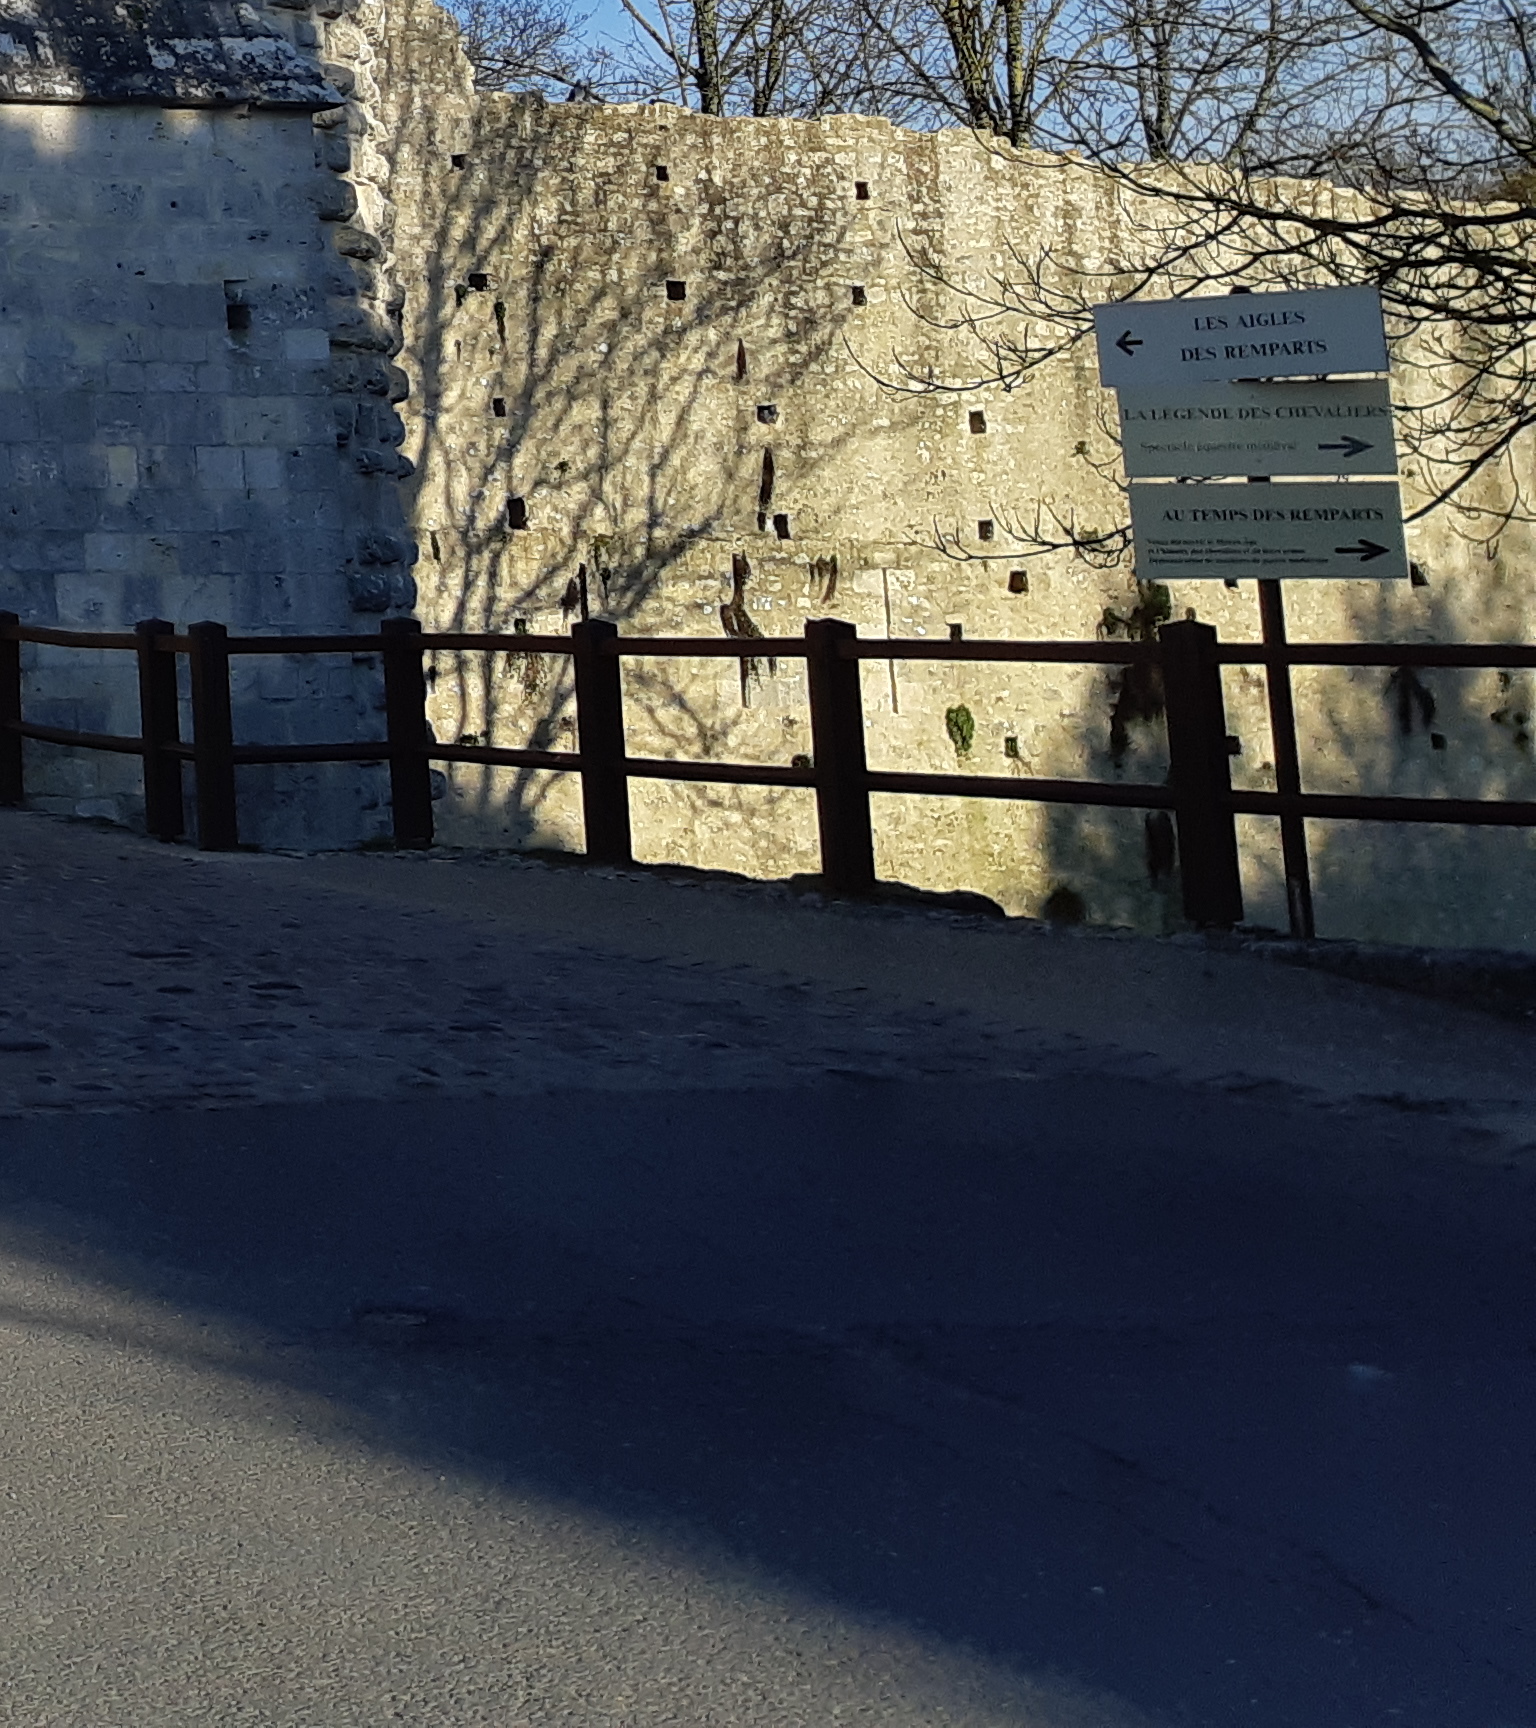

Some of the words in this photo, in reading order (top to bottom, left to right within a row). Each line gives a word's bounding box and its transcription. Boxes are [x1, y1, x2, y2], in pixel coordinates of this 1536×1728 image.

[1193, 315, 1228, 332] LES
[1236, 311, 1306, 329] AIGLES
[1180, 346, 1217, 362] DES
[1224, 339, 1328, 360] REMPARTS
[1124, 408, 1147, 422] LA
[1237, 406, 1271, 420] DES
[1275, 405, 1388, 419] CHEVALIERS
[1162, 509, 1185, 522] AU
[1190, 509, 1249, 522] TEMPS
[1252, 509, 1285, 522] DES
[1289, 509, 1383, 522] REMPARTS
